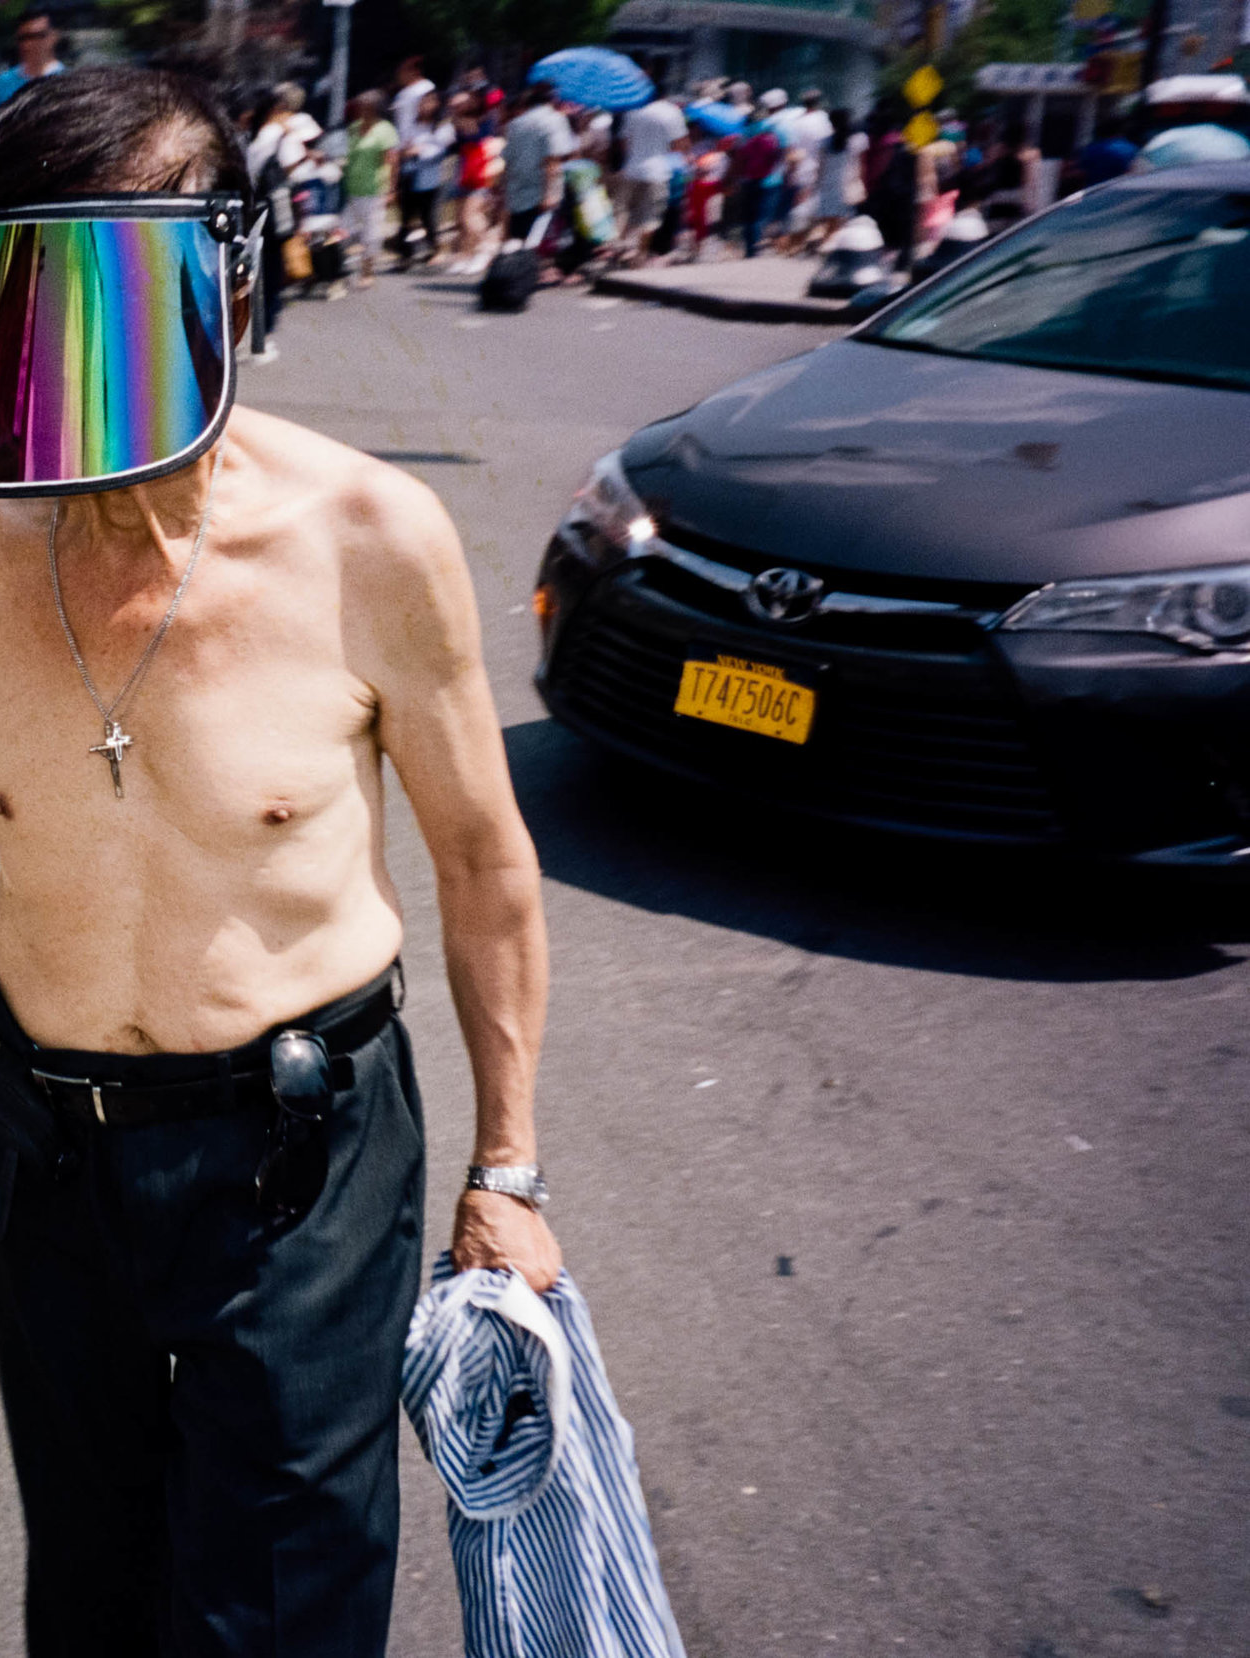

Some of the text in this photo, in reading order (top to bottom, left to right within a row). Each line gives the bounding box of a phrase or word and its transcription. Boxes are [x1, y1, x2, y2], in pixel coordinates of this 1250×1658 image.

[717, 654, 785, 680] NEW YORK
[692, 666, 800, 725] T747506C
